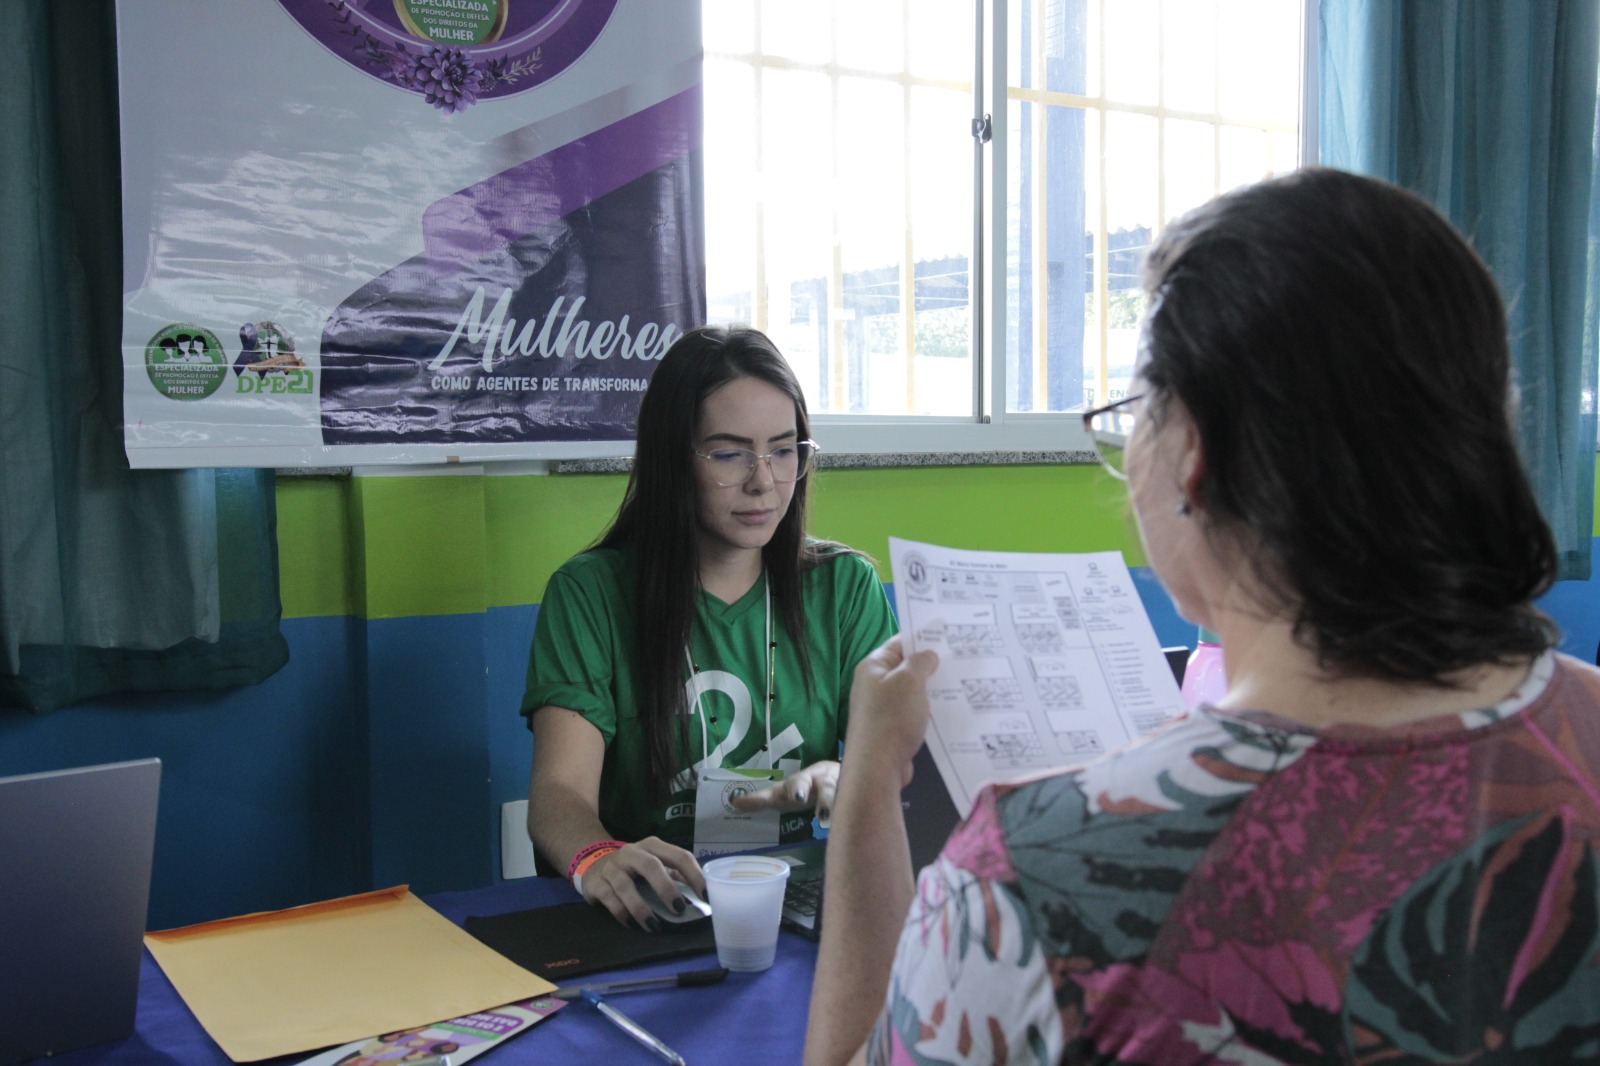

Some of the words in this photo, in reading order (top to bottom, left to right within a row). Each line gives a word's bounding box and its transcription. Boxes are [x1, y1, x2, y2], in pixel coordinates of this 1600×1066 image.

[423, 17, 438, 25] DOS
[438, 19, 468, 28] DIREITOS
[429, 27, 474, 41] MULHER
[427, 285, 684, 373] Mulheres
[155, 364, 219, 372] ESPECIALIZADA
[168, 386, 205, 394] MULHER
[431, 376, 471, 391] COMO
[476, 376, 538, 391] AGENTES
[542, 377, 559, 391] DE
[563, 377, 648, 392] TRANSFORMA
